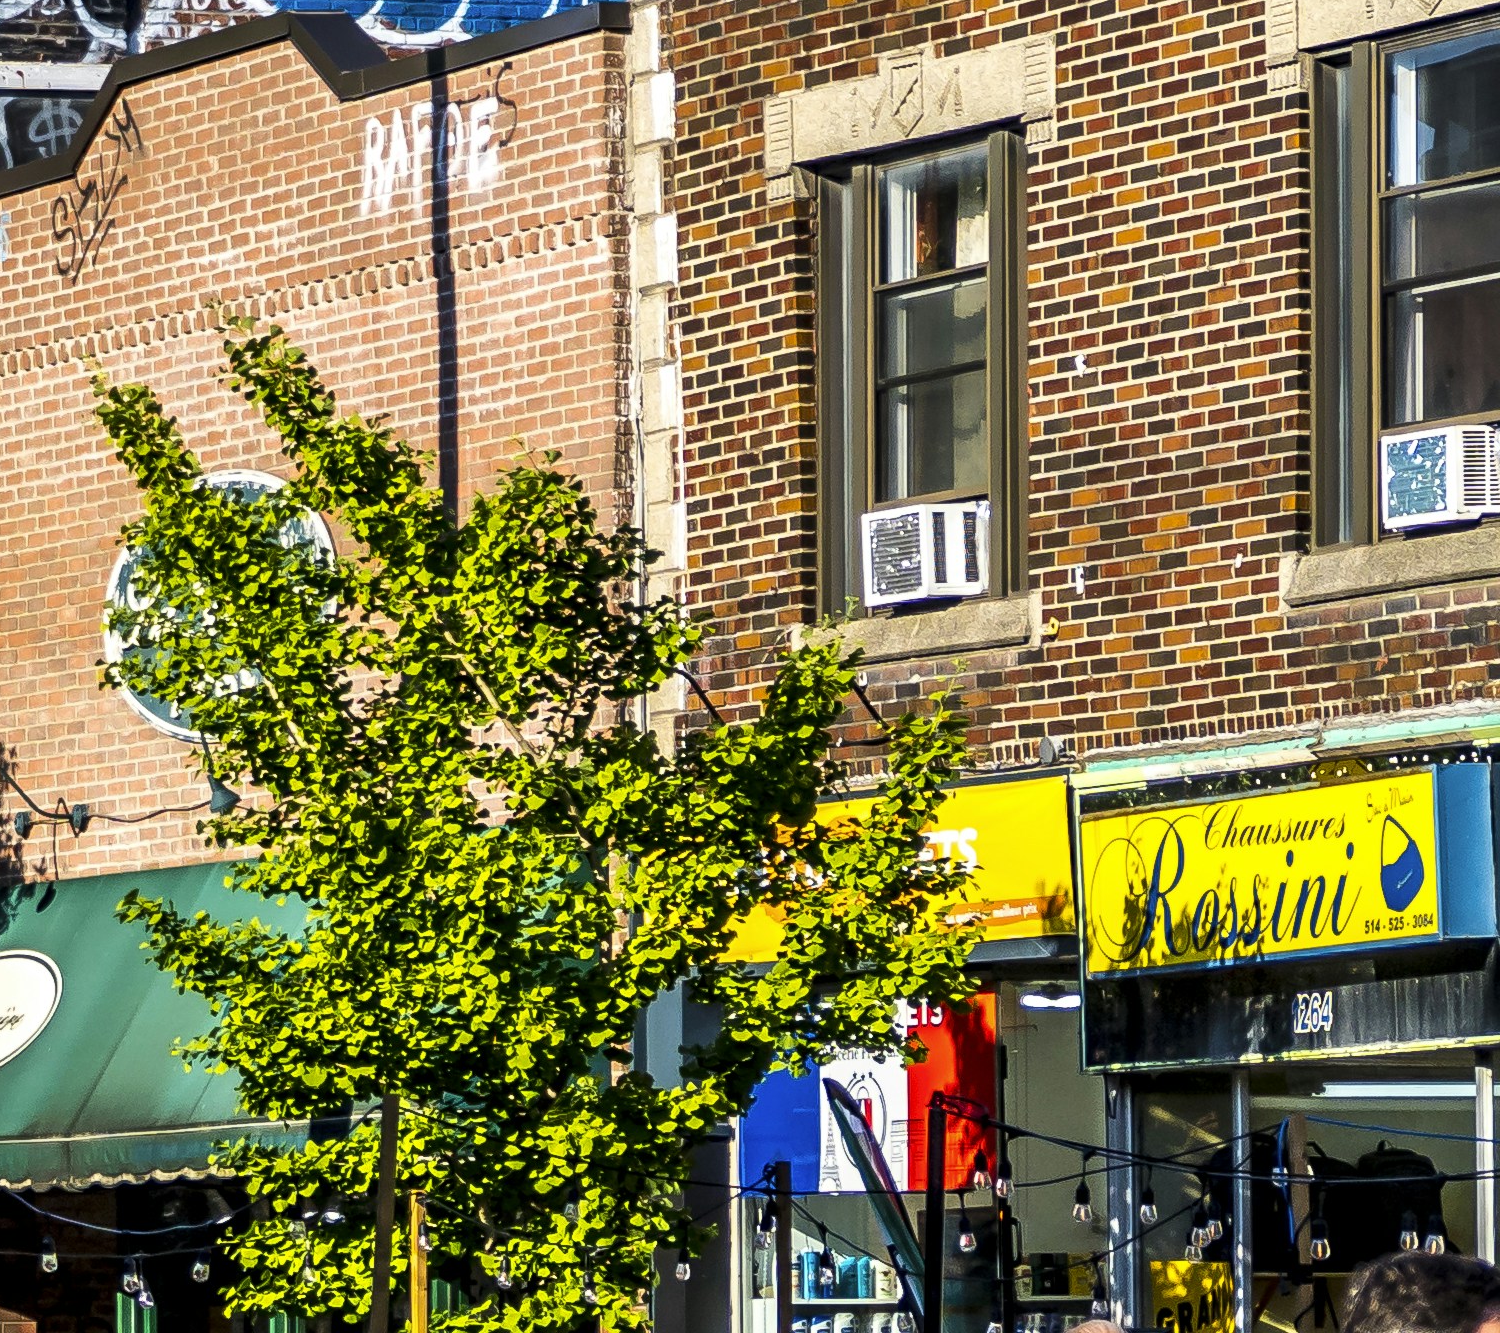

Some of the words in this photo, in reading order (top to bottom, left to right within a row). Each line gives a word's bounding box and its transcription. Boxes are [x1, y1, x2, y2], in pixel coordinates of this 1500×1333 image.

[1202, 803, 1348, 851] Chaussures
[1089, 813, 1363, 965] Rossini
[1364, 918, 1380, 935] 514
[1388, 916, 1405, 931] 525
[1291, 990, 1334, 1035] 1264
